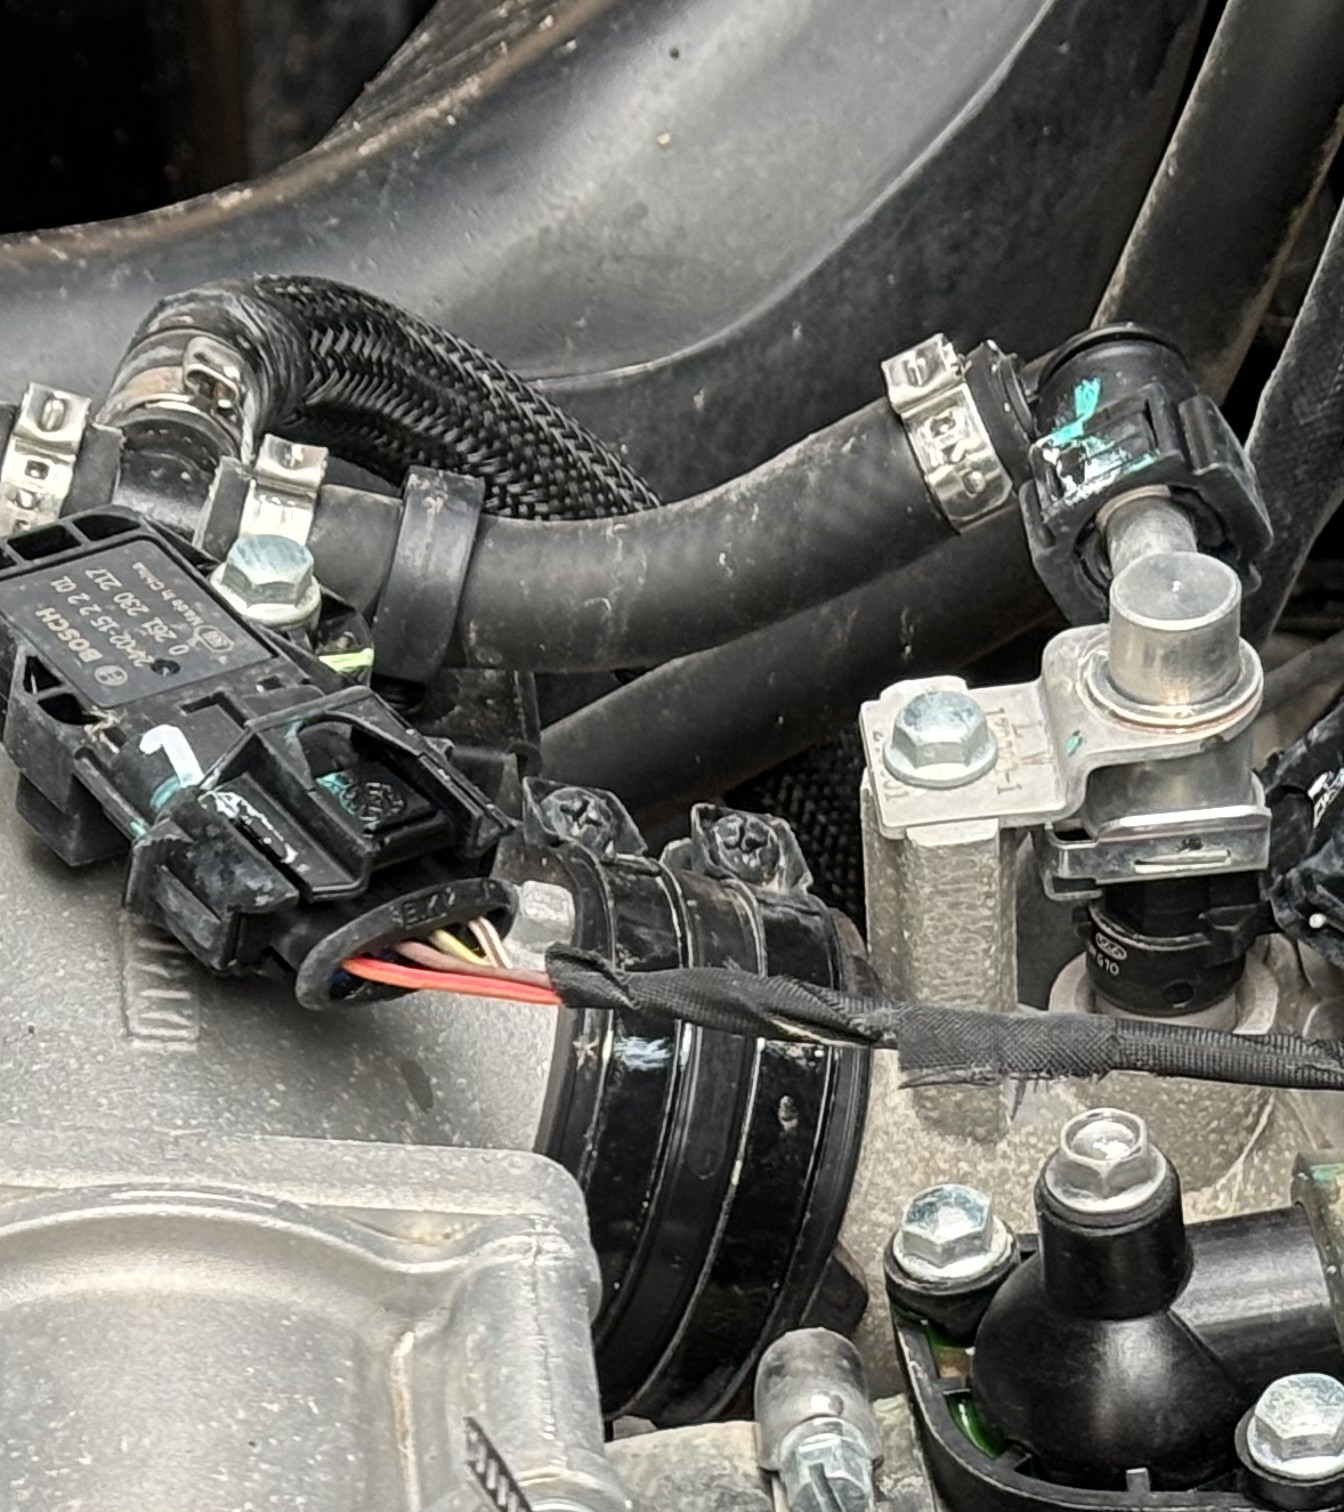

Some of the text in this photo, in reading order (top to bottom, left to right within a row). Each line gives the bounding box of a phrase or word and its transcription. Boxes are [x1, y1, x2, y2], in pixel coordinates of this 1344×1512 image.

[34, 606, 103, 663] BOSCH
[84, 566, 190, 655] 0 261 230 217
